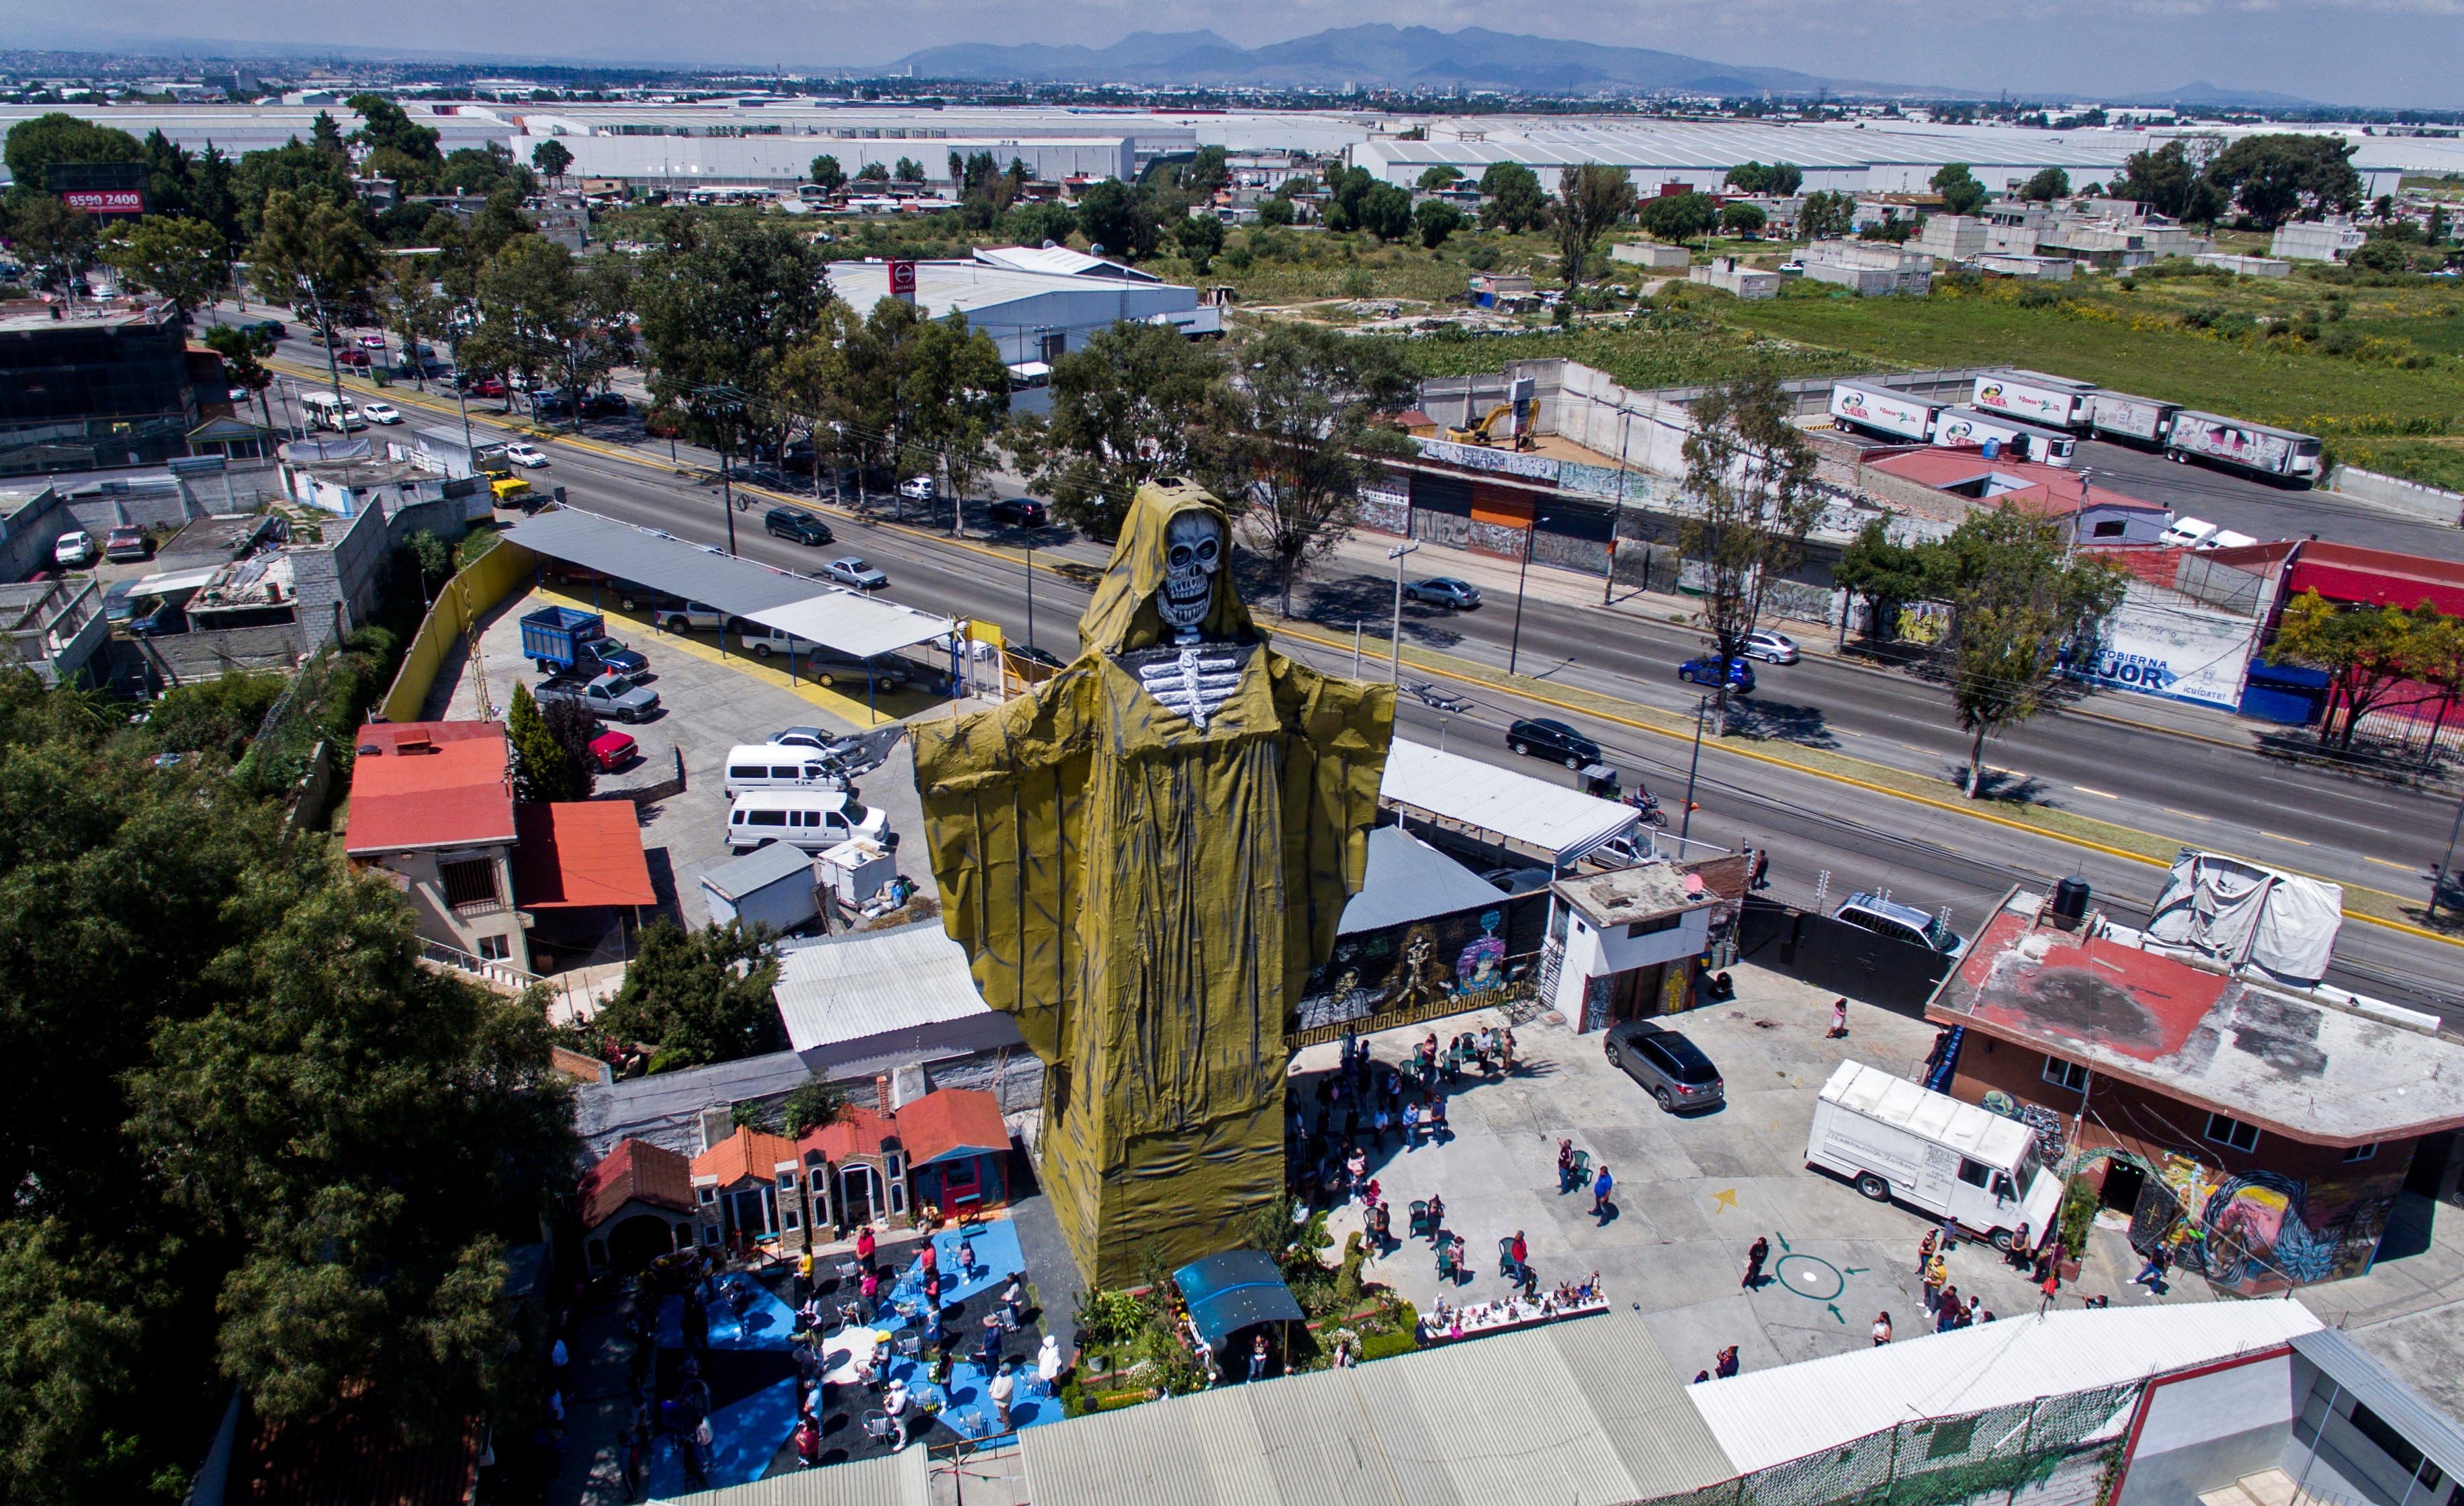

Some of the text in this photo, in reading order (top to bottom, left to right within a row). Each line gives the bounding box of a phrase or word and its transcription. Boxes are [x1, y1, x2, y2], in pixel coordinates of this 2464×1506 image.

[69, 194, 138, 206] 8590 2400
[2397, 480, 2412, 488] PATIO
[2097, 648, 2167, 669] GOBIERNA
[2058, 648, 2162, 690] EJOR
[2183, 686, 2226, 701] ¡CUÍDATE!
